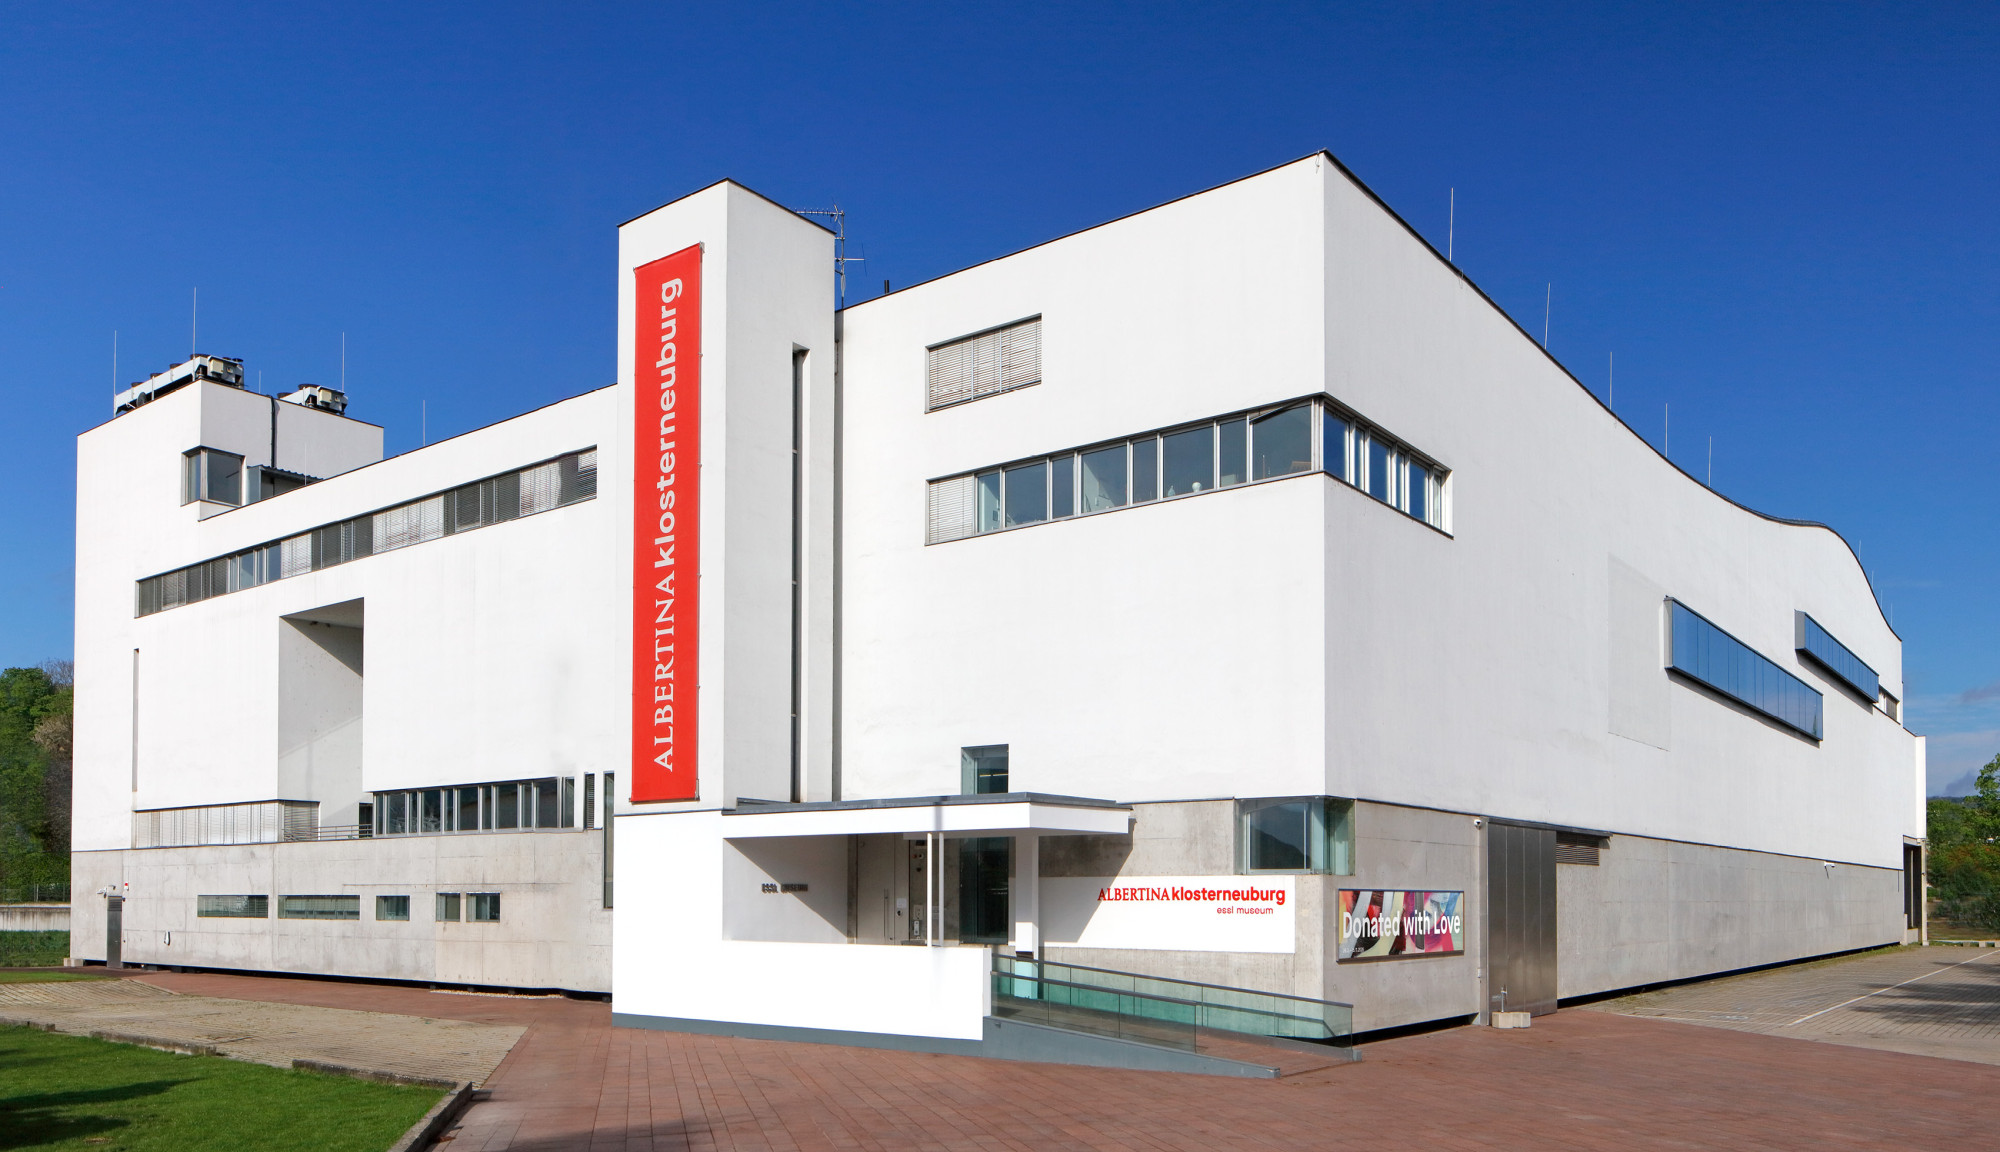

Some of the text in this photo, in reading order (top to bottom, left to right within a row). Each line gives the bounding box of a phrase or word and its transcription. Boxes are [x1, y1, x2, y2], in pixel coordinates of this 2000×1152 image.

[1216, 906, 1274, 915] essl museum
[1342, 910, 1461, 939] Donated with Love
